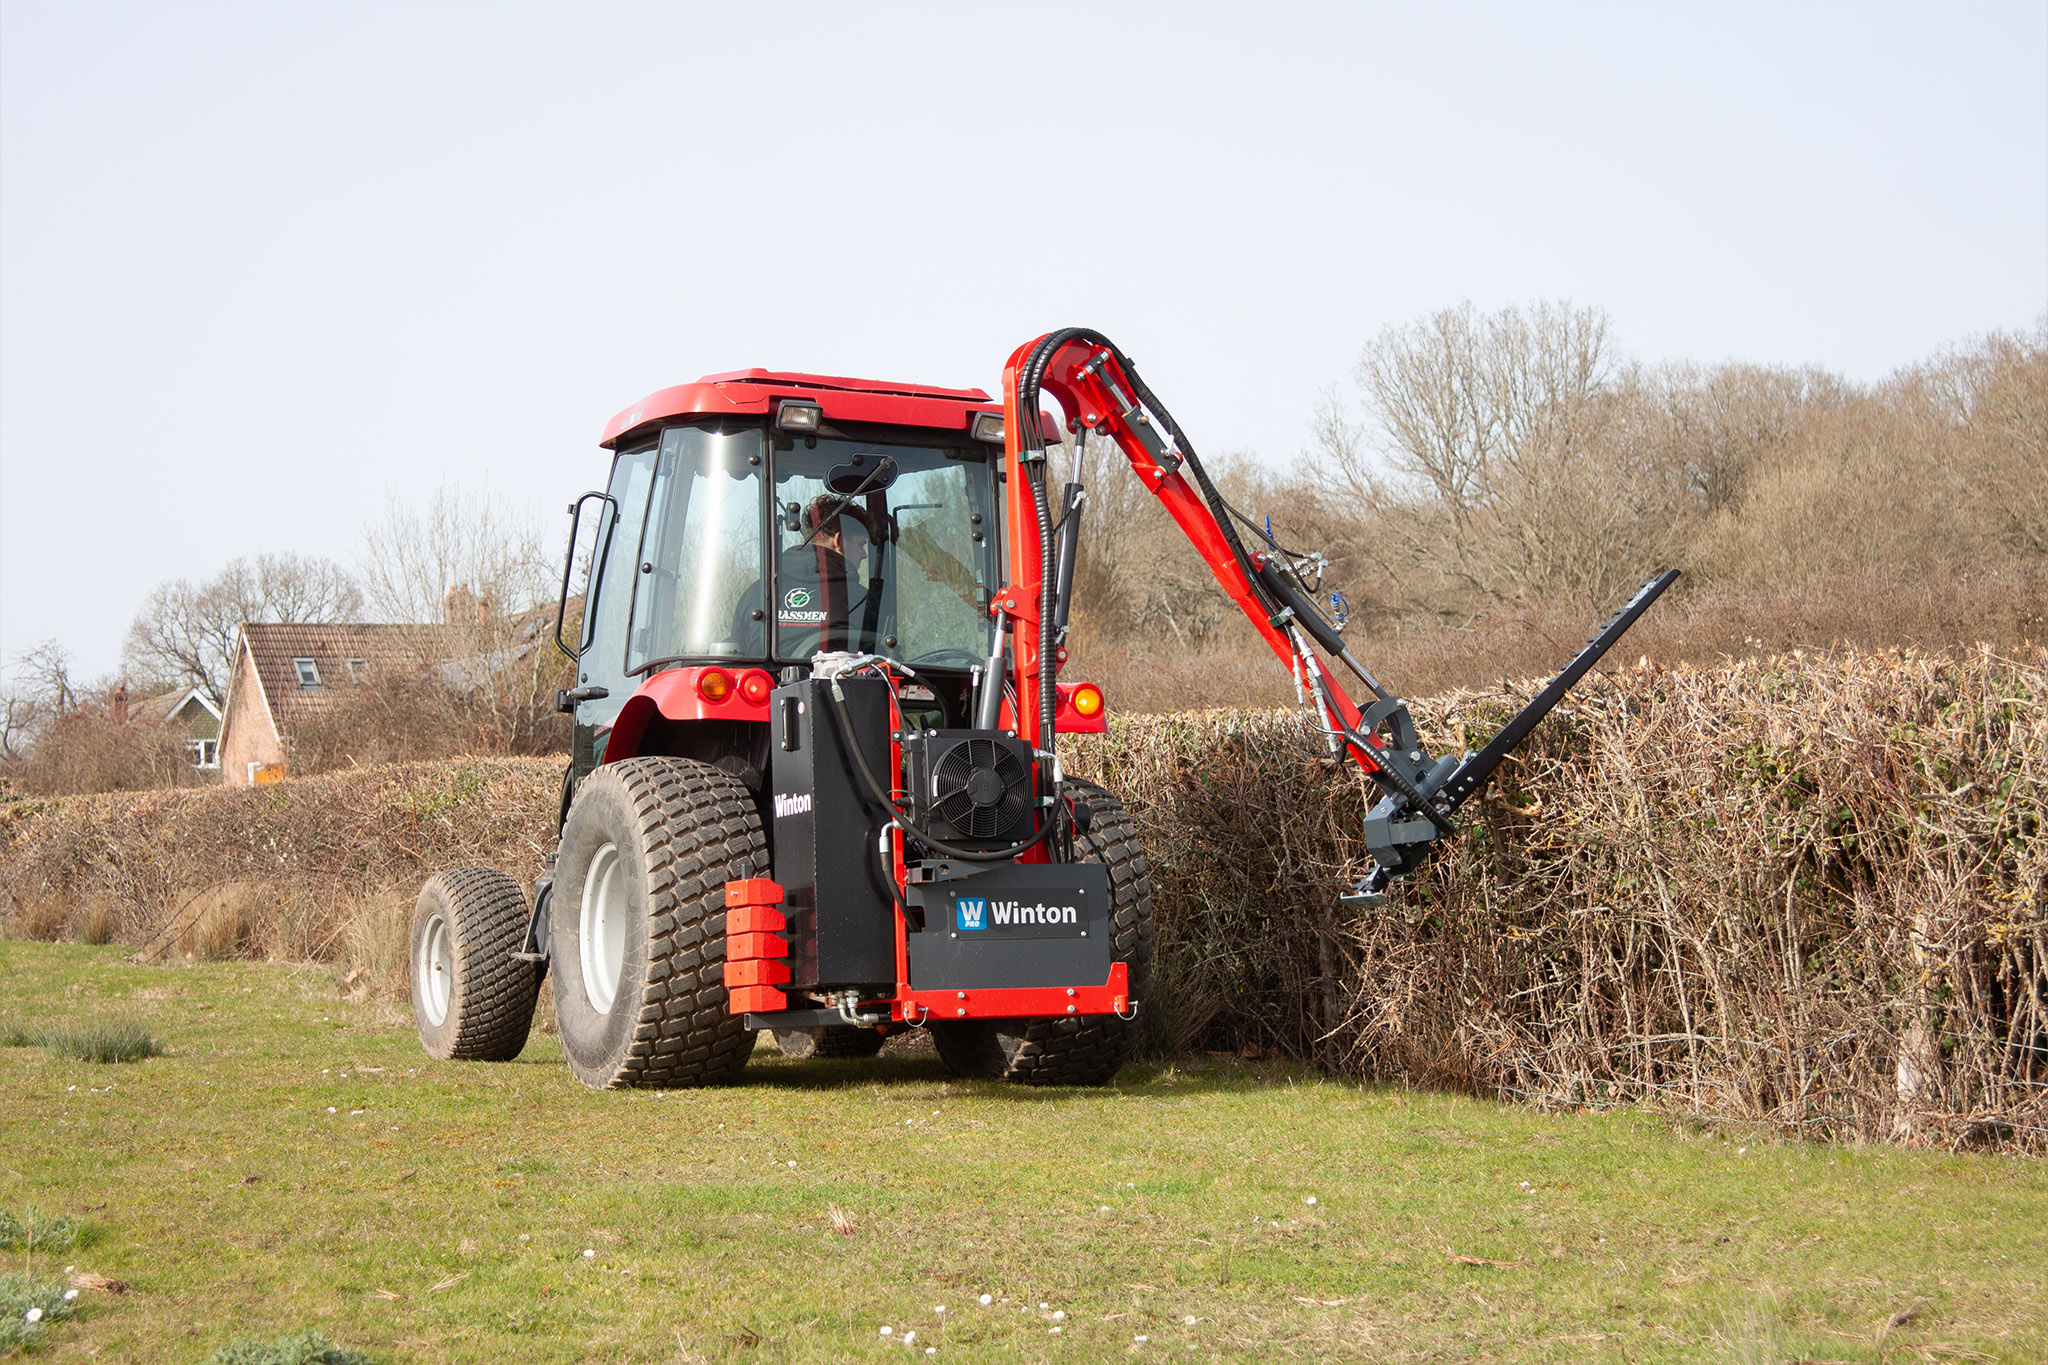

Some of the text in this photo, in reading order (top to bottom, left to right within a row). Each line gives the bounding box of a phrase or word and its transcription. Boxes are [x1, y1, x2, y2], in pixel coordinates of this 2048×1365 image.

[778, 610, 828, 621] RASSMEN
[774, 793, 812, 818] Winton
[960, 901, 1077, 925] W Winton
[964, 920, 980, 928] PRO
